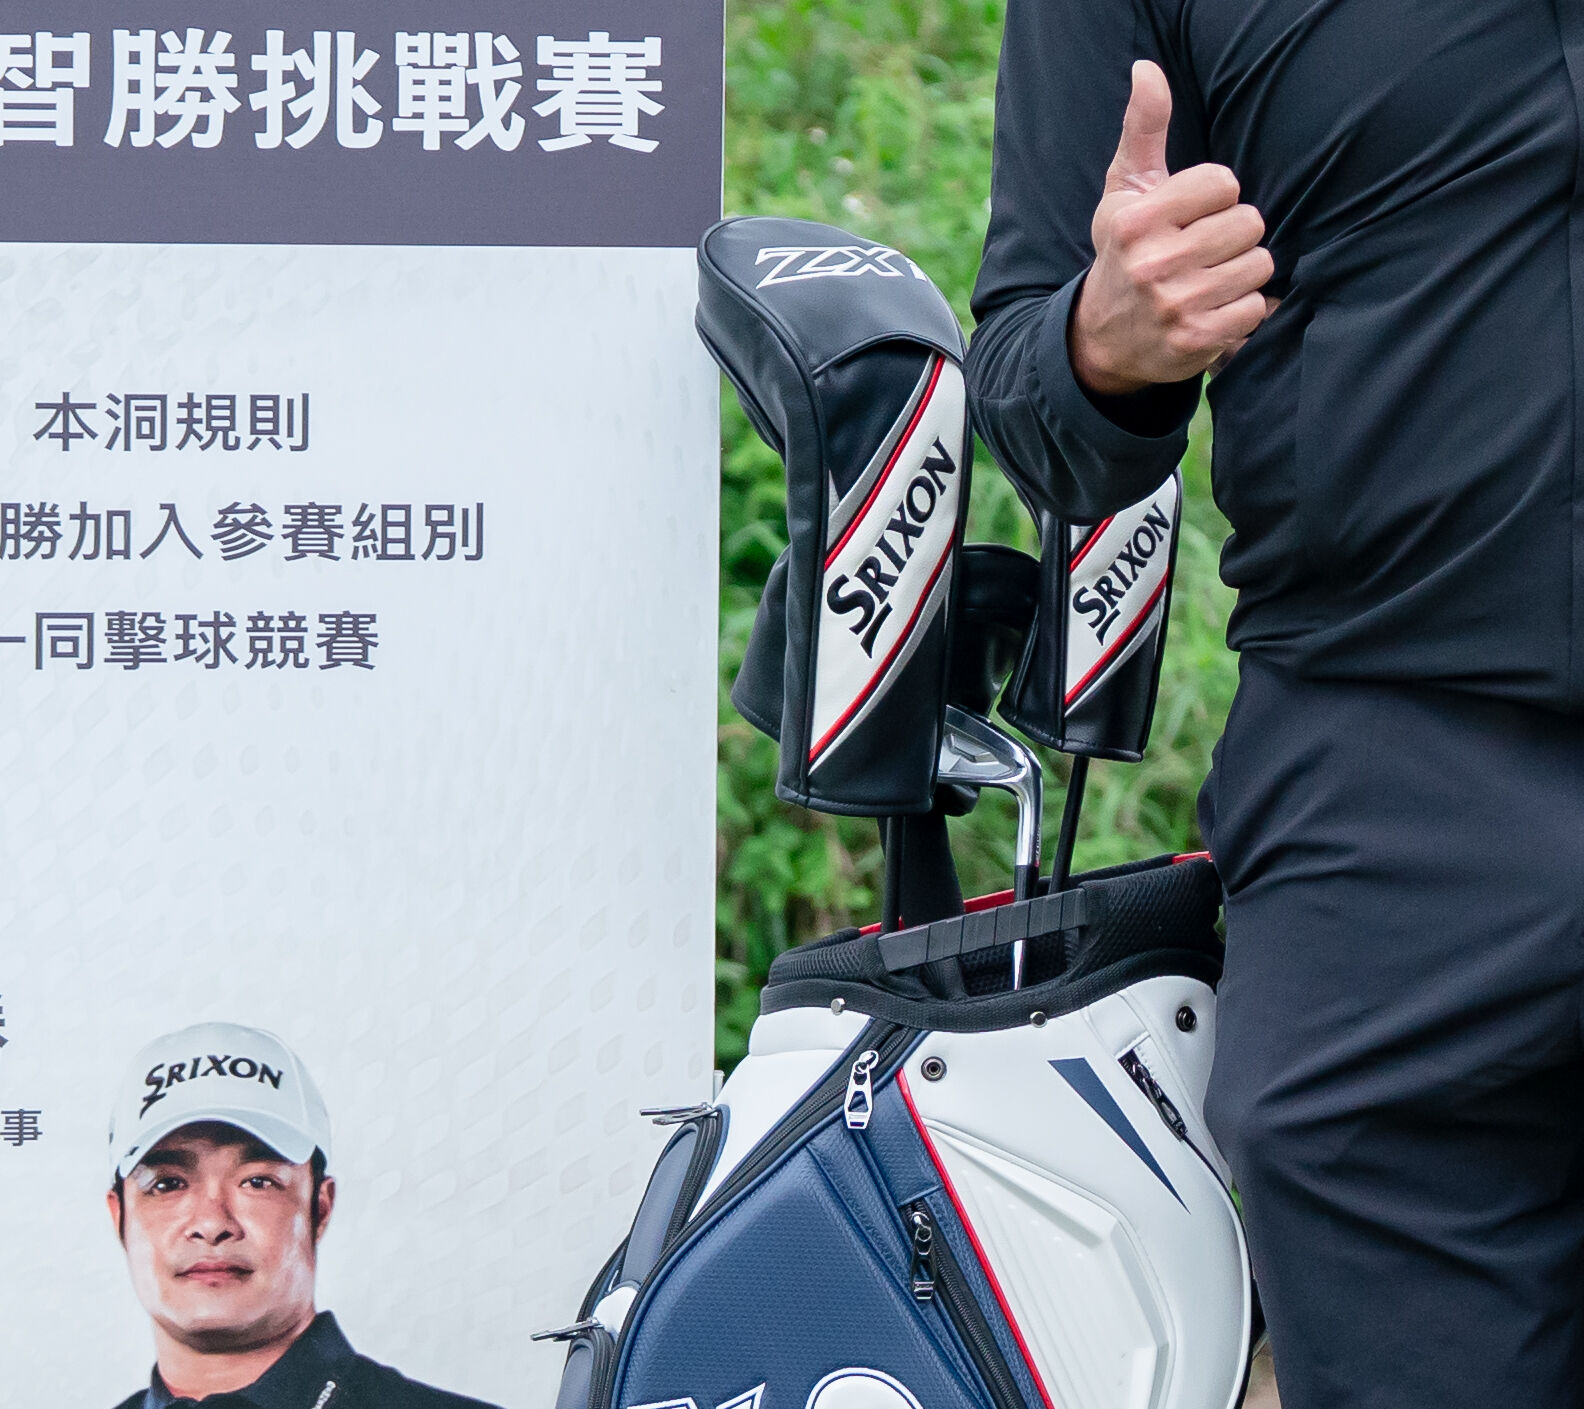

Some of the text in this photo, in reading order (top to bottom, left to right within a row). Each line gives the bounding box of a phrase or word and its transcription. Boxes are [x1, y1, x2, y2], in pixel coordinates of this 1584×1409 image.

[32, 391, 311, 452] 本洞規則
[827, 436, 956, 659] SRIXON
[1072, 501, 1170, 646] SRIXON
[139, 1055, 283, 1119] SRIXON
